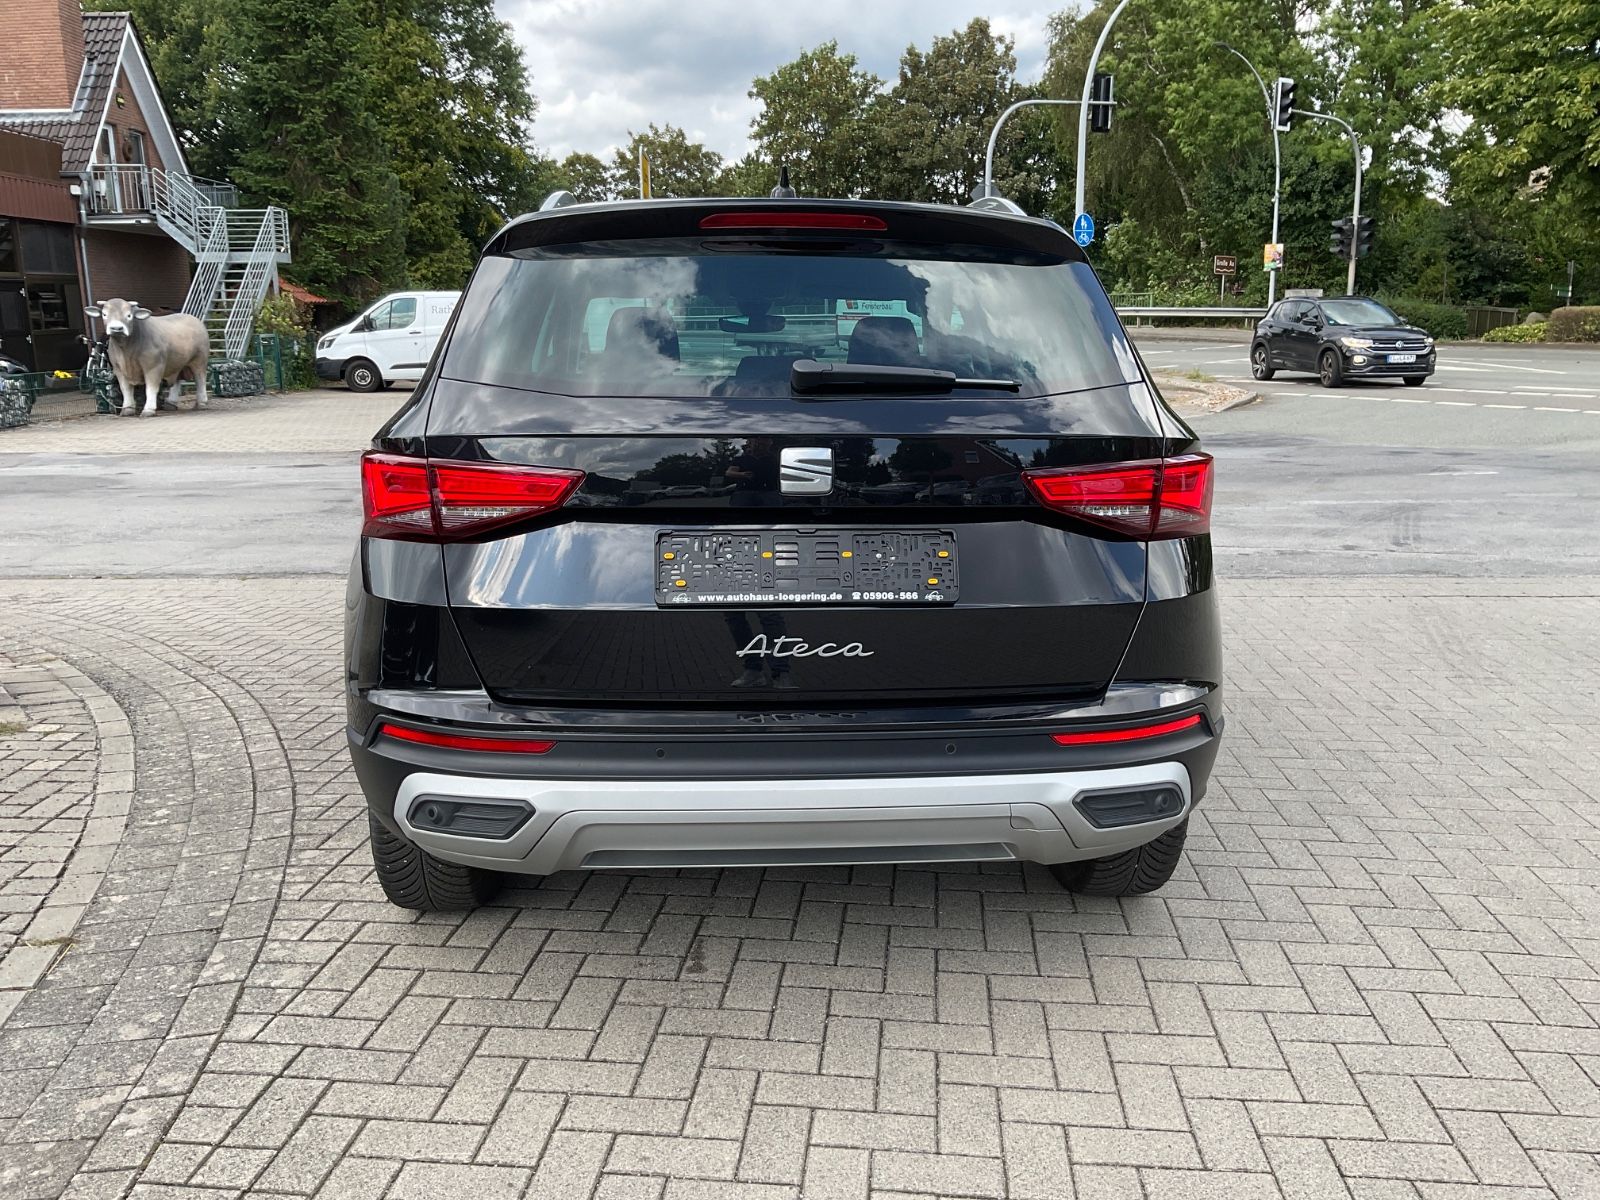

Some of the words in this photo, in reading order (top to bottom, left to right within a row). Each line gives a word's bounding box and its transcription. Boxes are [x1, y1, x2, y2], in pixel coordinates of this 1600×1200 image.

[698, 591, 843, 602] www.autohaus-loegering.de
[862, 591, 919, 601] 05906-566
[736, 633, 875, 658] Ateca
